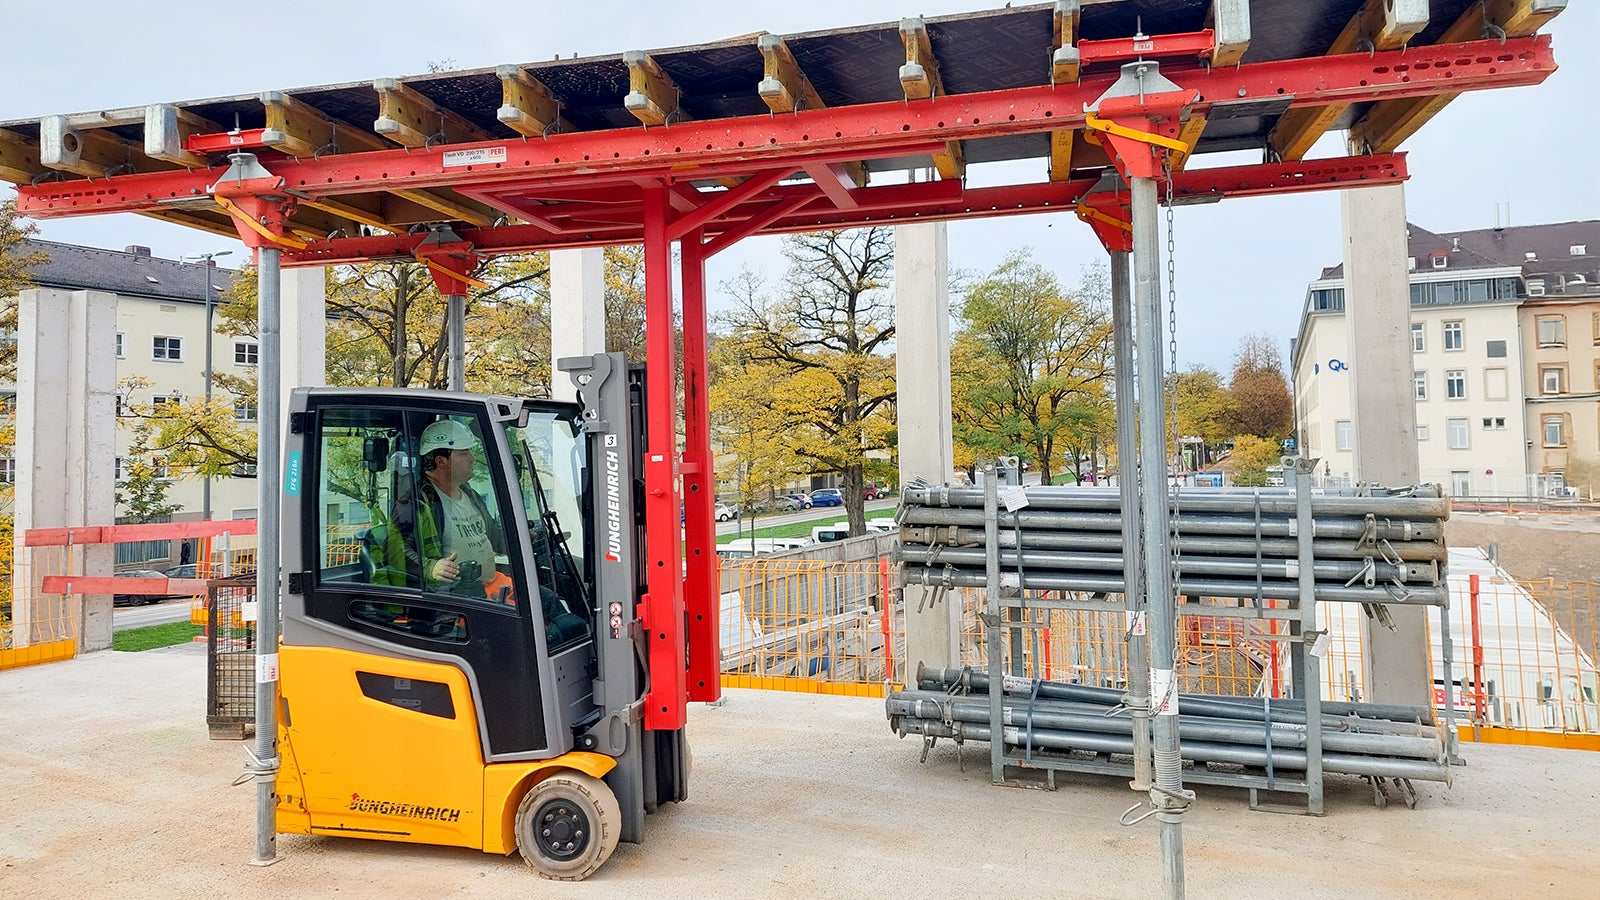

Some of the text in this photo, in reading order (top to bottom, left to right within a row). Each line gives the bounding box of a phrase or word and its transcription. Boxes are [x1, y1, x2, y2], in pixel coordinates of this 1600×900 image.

[607, 436, 615, 446] 3
[605, 450, 622, 564] JUNGHEINRICH
[348, 794, 461, 822] JUNGHEINRICH
